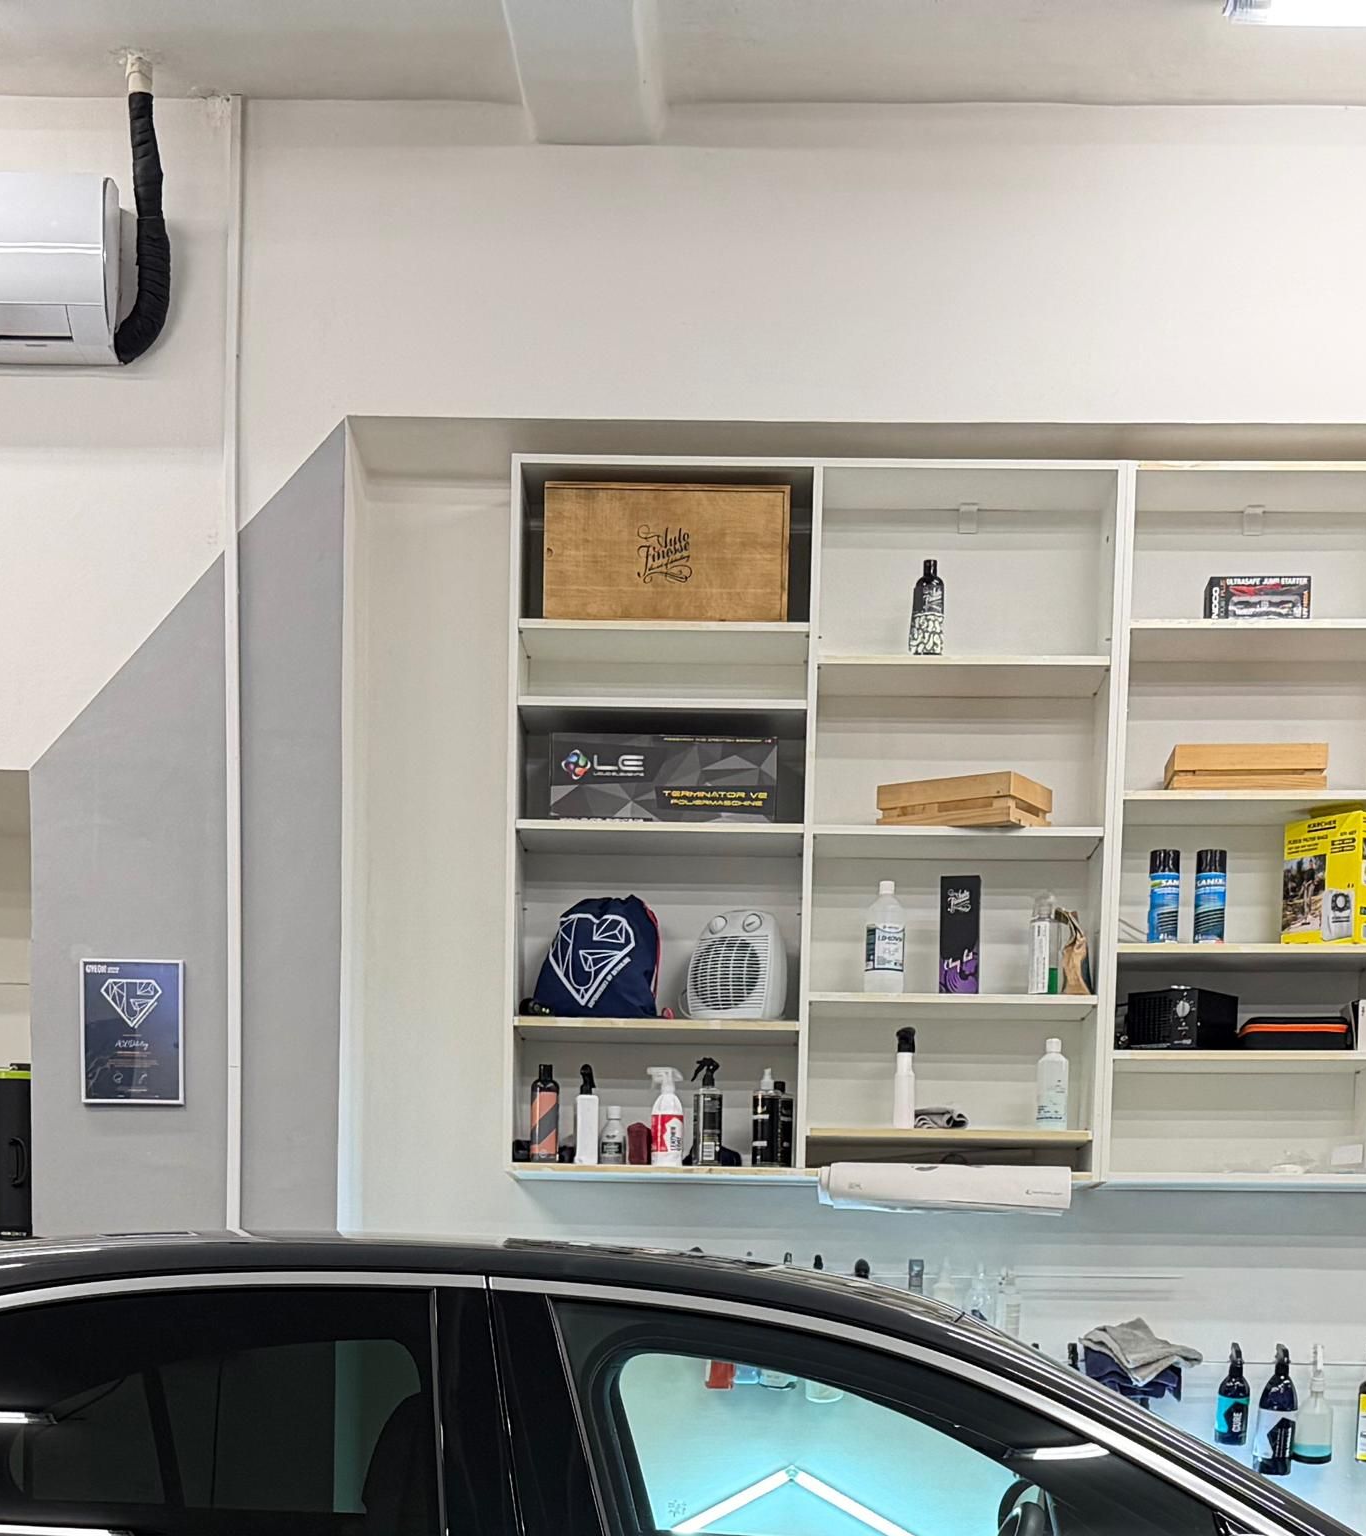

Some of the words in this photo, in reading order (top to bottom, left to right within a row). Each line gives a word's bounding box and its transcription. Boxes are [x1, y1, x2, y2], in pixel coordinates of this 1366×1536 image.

[593, 754, 645, 771] LE
[663, 790, 747, 799] TERMINATOR
[670, 798, 764, 807] POLIERMASCHINE
[1232, 1412, 1242, 1433] CURE
